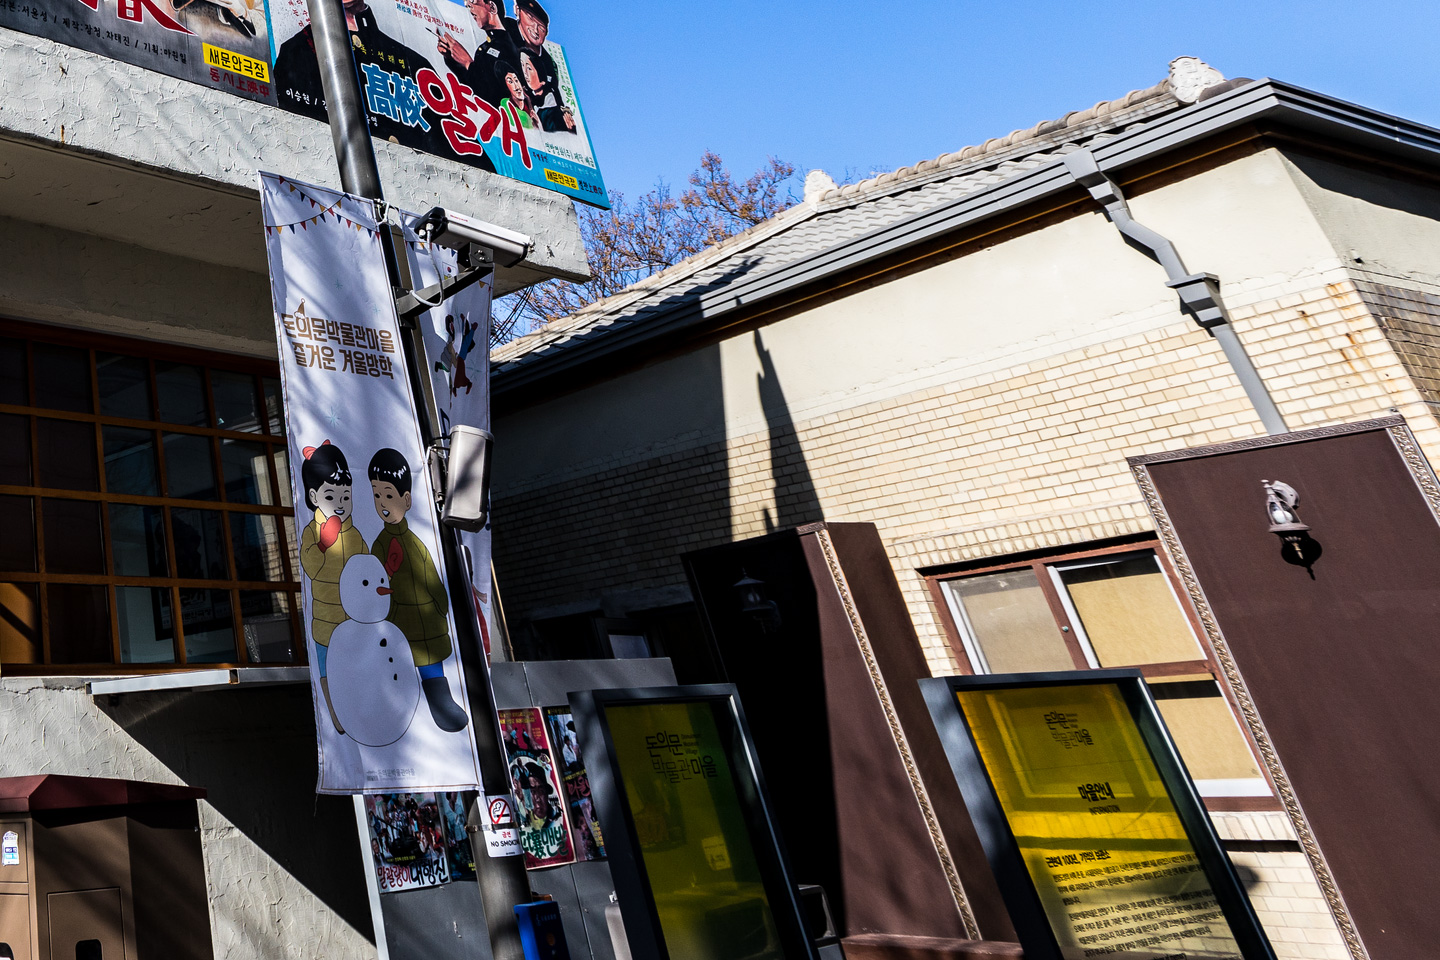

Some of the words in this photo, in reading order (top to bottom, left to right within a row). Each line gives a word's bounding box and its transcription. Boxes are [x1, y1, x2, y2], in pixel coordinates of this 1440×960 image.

[209, 48, 265, 79] 새문안극장
[285, 88, 310, 105] 이승현
[415, 67, 533, 170] 얄개
[546, 170, 577, 189] 새문안극장
[281, 313, 395, 353] 돈의문박물관마을
[291, 341, 336, 371] 즐거운
[338, 349, 394, 380] 겨울방학
[1043, 711, 1070, 730] 돈의문
[646, 730, 683, 757] 돈의문
[1050, 728, 1094, 750] 박물관마을
[652, 755, 718, 783] 박물관마을
[1077, 781, 1115, 802] 마을안내
[1088, 804, 1121, 815] INFORMATION
